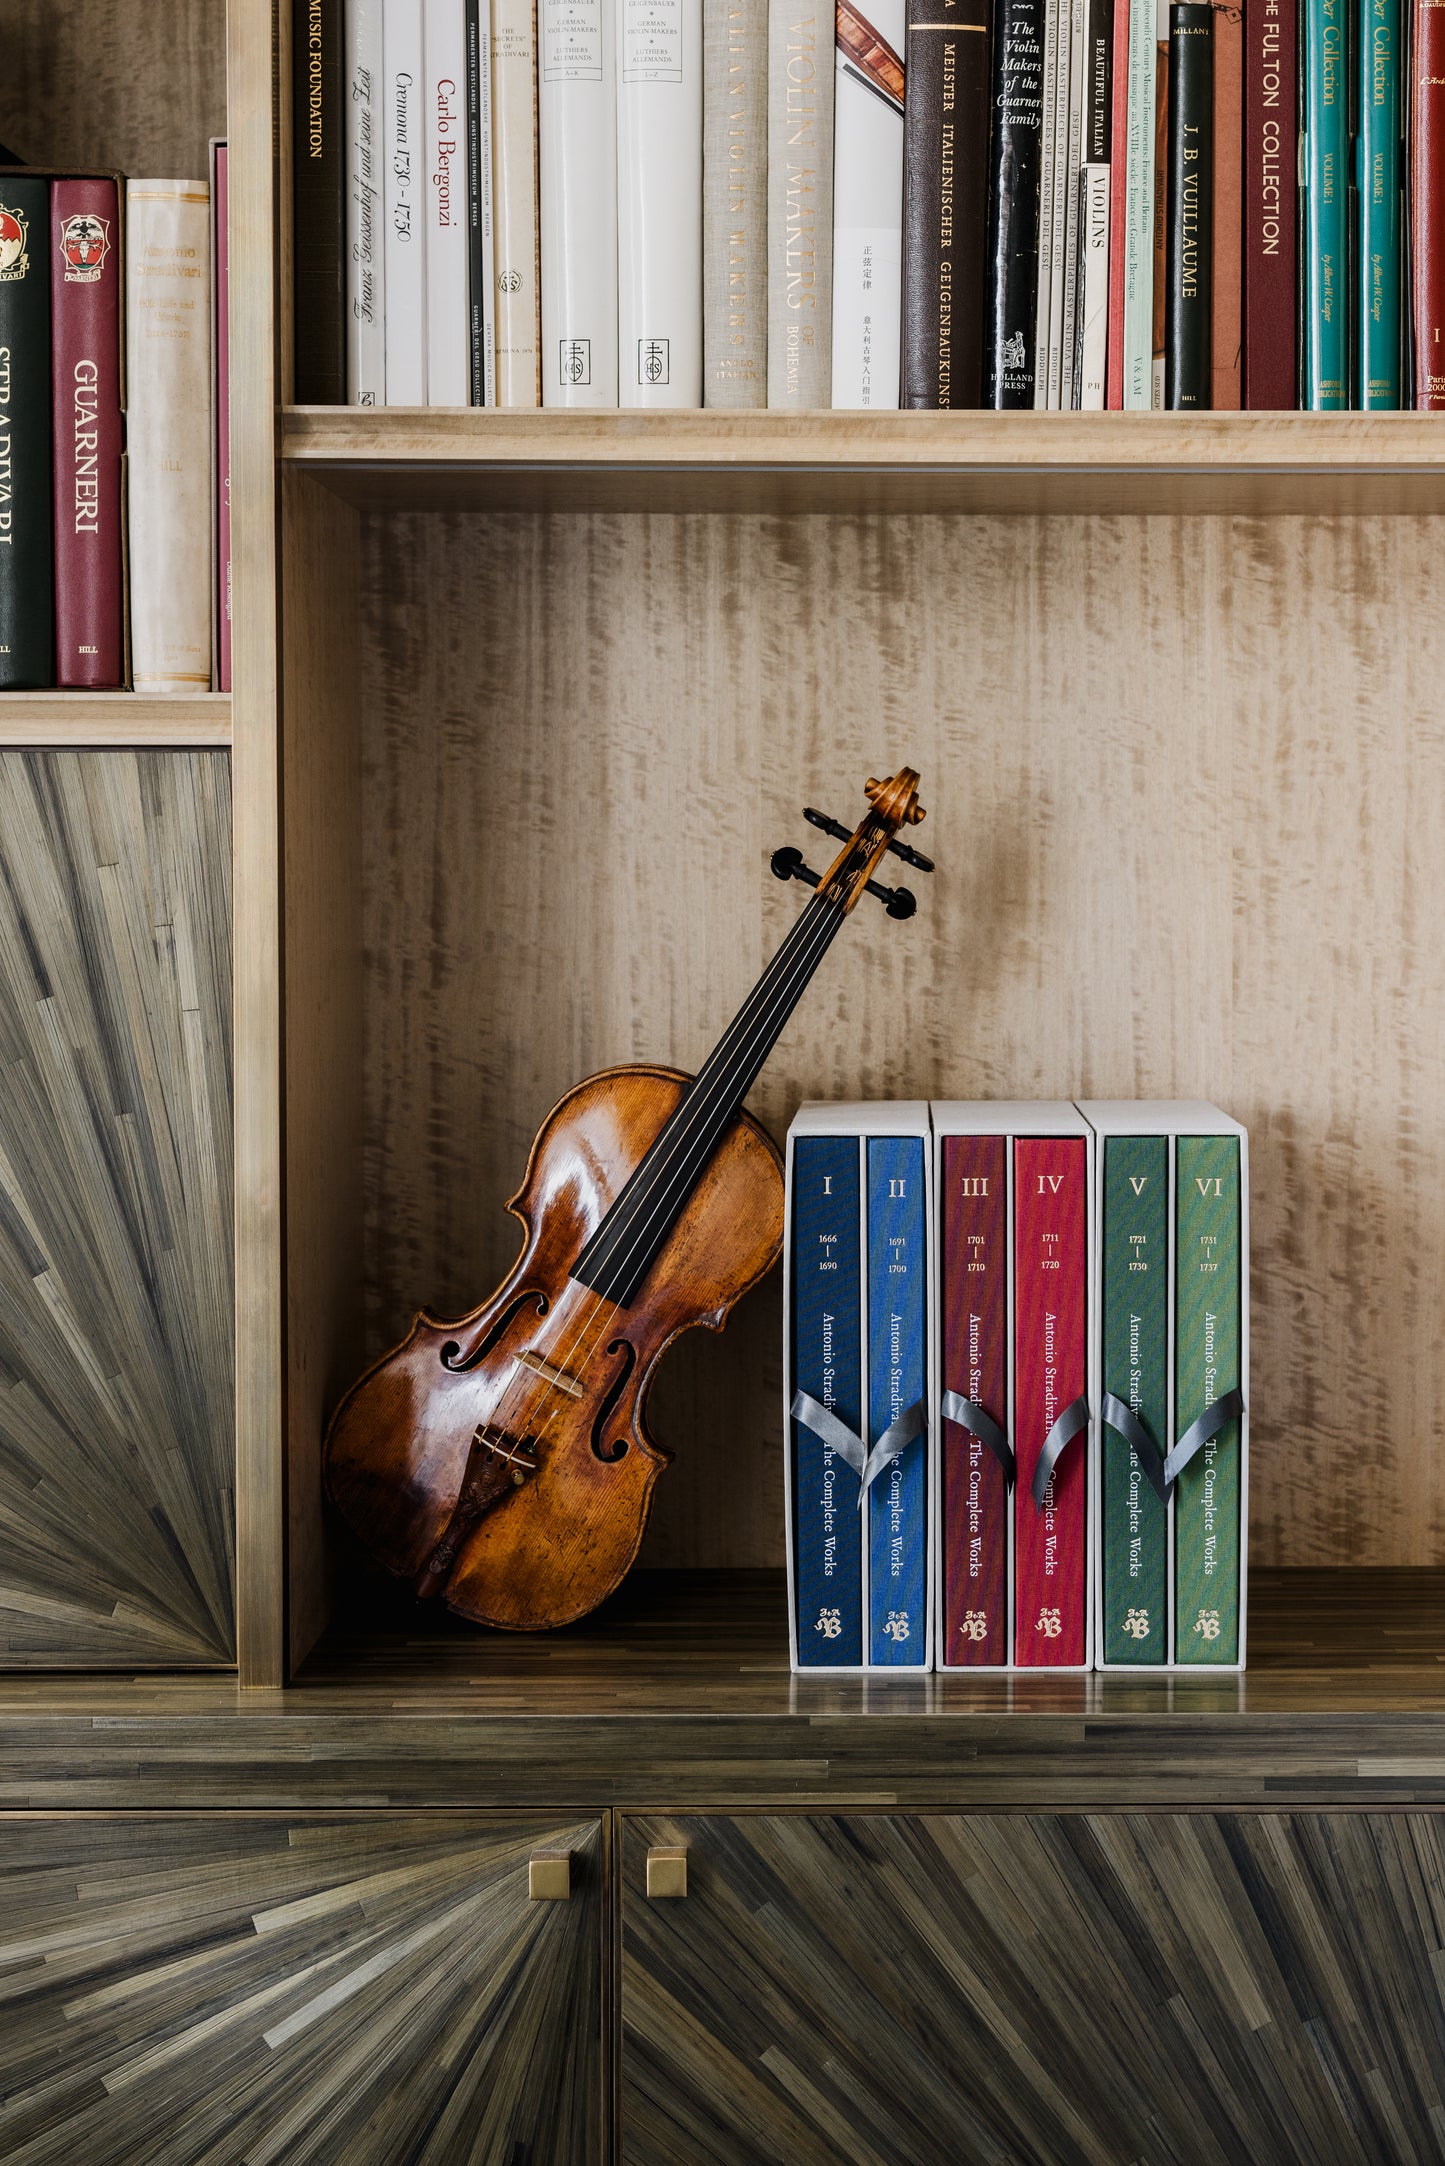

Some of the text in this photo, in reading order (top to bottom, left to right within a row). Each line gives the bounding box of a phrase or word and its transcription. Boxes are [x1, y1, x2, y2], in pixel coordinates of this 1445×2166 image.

[1012, 21, 1035, 35] The
[1048, 20, 1056, 57] VIOLIN
[1060, 20, 1068, 57] VIOLIN
[1131, 7, 1139, 58] instruments
[1005, 39, 1040, 54] Violin
[309, 0, 322, 159] MUSIC FOUNDATION
[943, 43, 956, 112] MEISTER
[1000, 58, 1042, 72] Makers
[1131, 61, 1140, 71] de
[1323, 26, 1340, 107] Collection
[1374, 26, 1391, 107] Collection
[1004, 76, 1038, 92] of the
[1045, 63, 1055, 138] MASTERPIECES
[1058, 63, 1067, 138] MASTERPIECES
[1094, 39, 1106, 156] BEAUTIFUL ITALIAN
[1130, 73, 1138, 109] musique
[1000, 112, 1041, 130] Family
[1131, 111, 1137, 121] au
[1262, 0, 1280, 255] HE FULTON COLLECTION
[432, 79, 457, 227] Carlo Bergonzi
[1045, 144, 1051, 156] OF
[1057, 144, 1064, 159] OF
[1142, 37, 1152, 234] Century Musical France and Britain
[393, 72, 413, 242] Cremona 1730 1750
[786, 17, 817, 345] VIOLIN MAKERS OF
[941, 124, 954, 248] ITALIENISCHER
[1043, 161, 1051, 214] GUARNERI
[1056, 161, 1064, 214] GUARNERI
[1069, 166, 1078, 220] GUARNERI
[1323, 153, 1334, 198] VOLUME
[1374, 153, 1385, 198] VOLUME
[352, 65, 377, 323] Franz Geissenhof und seine Zeit
[1129, 188, 1138, 215] France
[1155, 169, 1164, 249] ANTONIO STRADIVARI
[1182, 124, 1199, 298] J. B. VUILLAUME
[728, 111, 746, 345] VIOLIN MAKERS
[1055, 220, 1063, 239] DEL
[1069, 224, 1076, 238] OF
[1091, 177, 1106, 249] VIOLINS
[1129, 228, 1138, 260] Grande
[1321, 254, 1333, 264] by
[1371, 254, 1383, 264] by
[862, 245, 872, 290] 正弦定律
[1066, 242, 1076, 318] MASTERPIECES
[1128, 263, 1138, 300] Bretagne
[1323, 264, 1333, 286] Albert
[1374, 264, 1384, 286] Albert
[1321, 297, 1333, 323] Cooper
[1371, 297, 1383, 323] Cooper
[1065, 323, 1073, 360] VIOLIN
[1434, 328, 1441, 343] I
[786, 326, 800, 394] BOHEMIA
[990, 373, 1034, 382] HOLLAND
[1038, 347, 1046, 390] BIDDULPH
[999, 381, 1026, 390] PRESS
[74, 359, 98, 534] GUARNERI
[78, 645, 98, 653] HILL
[823, 1176, 832, 1195] I
[888, 1179, 906, 1197] II
[962, 1177, 989, 1196] III
[1037, 1175, 1064, 1194] IV
[1129, 1177, 1148, 1196] V
[1195, 1178, 1223, 1196] VI
[818, 1234, 837, 1243] 1666
[888, 1237, 906, 1246] 1691
[967, 1236, 985, 1245] 1701
[1041, 1234, 1059, 1242] 1711
[1128, 1235, 1147, 1244] 1721
[1199, 1236, 1217, 1244] 1731
[818, 1261, 837, 1270] 1690
[888, 1264, 907, 1273] 1700
[967, 1263, 985, 1272] 1710
[1041, 1260, 1060, 1269] 1720
[1128, 1262, 1148, 1271] 1730
[1199, 1263, 1218, 1272] 1737
[823, 1312, 835, 1364] Antonio
[1045, 1312, 1057, 1363] Antonio
[887, 1312, 904, 1577] Antonio Stradiva Complete Works
[966, 1313, 983, 1578] Antonio The Complete Works
[1126, 1313, 1143, 1577] Antonio Complete Works
[1200, 1312, 1218, 1576] Antonio The Complete Works
[820, 1471, 837, 1532] Complete
[823, 1535, 837, 1577] Works
[1045, 1534, 1058, 1576] Works
